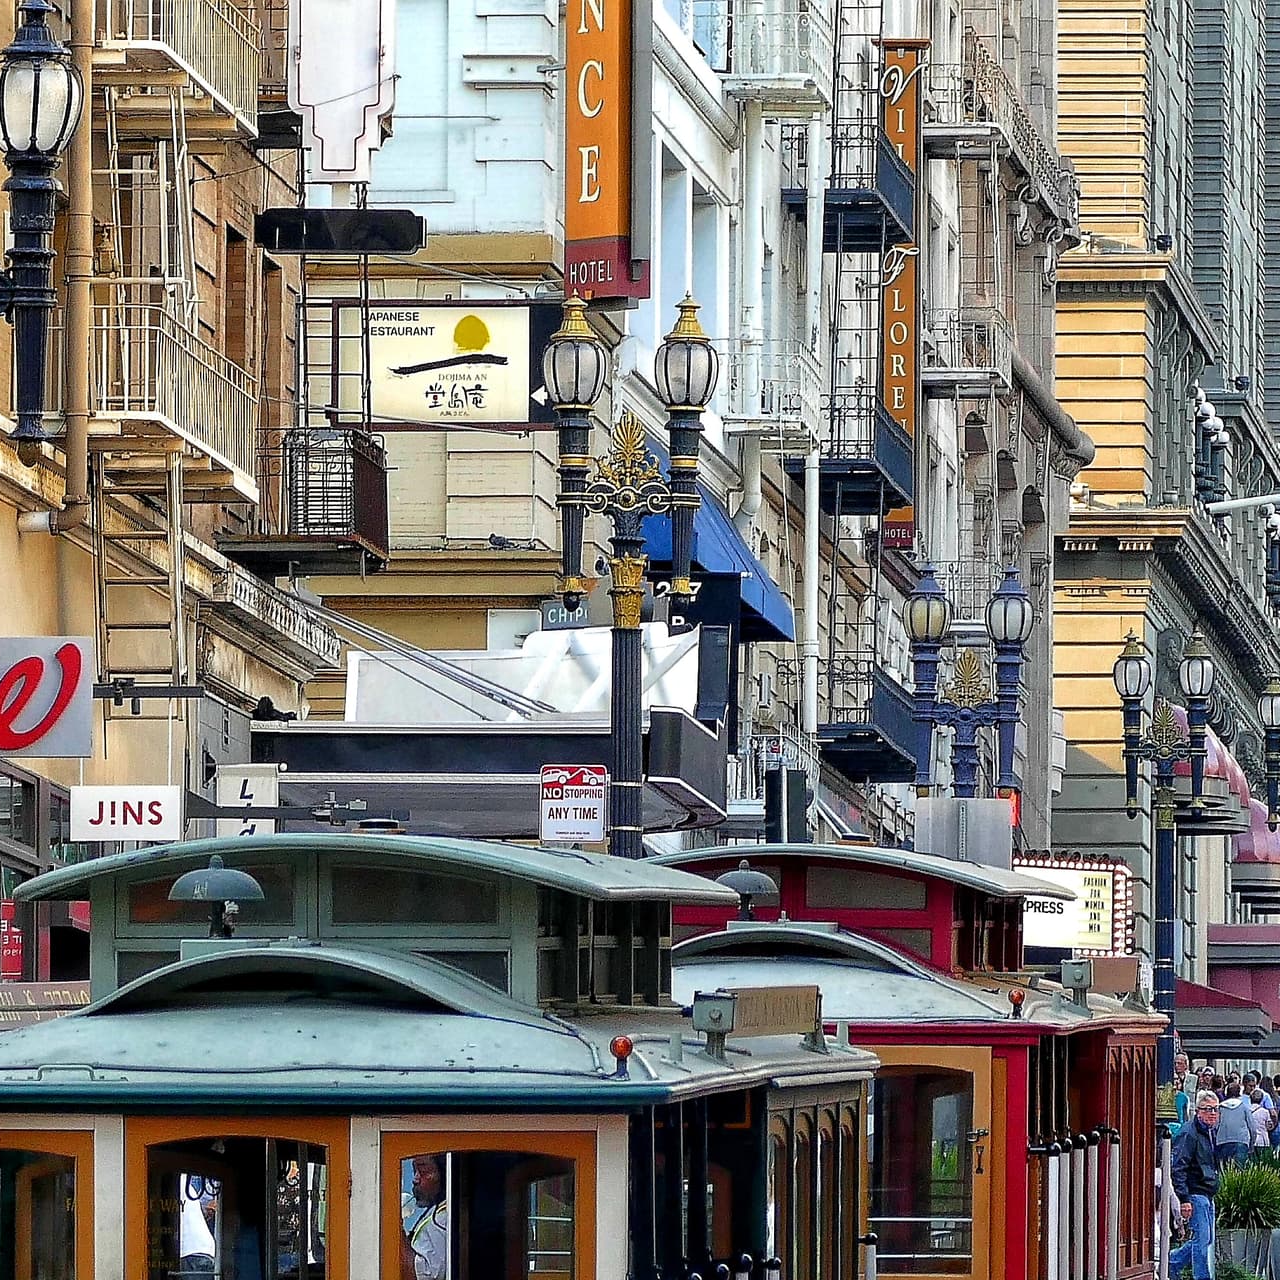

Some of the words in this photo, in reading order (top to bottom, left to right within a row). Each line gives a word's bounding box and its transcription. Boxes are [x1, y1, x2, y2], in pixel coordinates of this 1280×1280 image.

[570, 260, 613, 285] HOTEL
[370, 312, 419, 321] APANESE
[371, 327, 435, 336] ESTAURANT
[438, 374, 471, 382] DOJIMA
[885, 529, 911, 538] HOTEL
[544, 788, 562, 799] NO
[564, 788, 603, 799] STOPPING
[548, 807, 571, 820] ANY
[573, 807, 597, 819] TIME
[1090, 889, 1100, 898] FOR
[1090, 912, 1100, 921] AND
[1089, 923, 1100, 932] MEN
